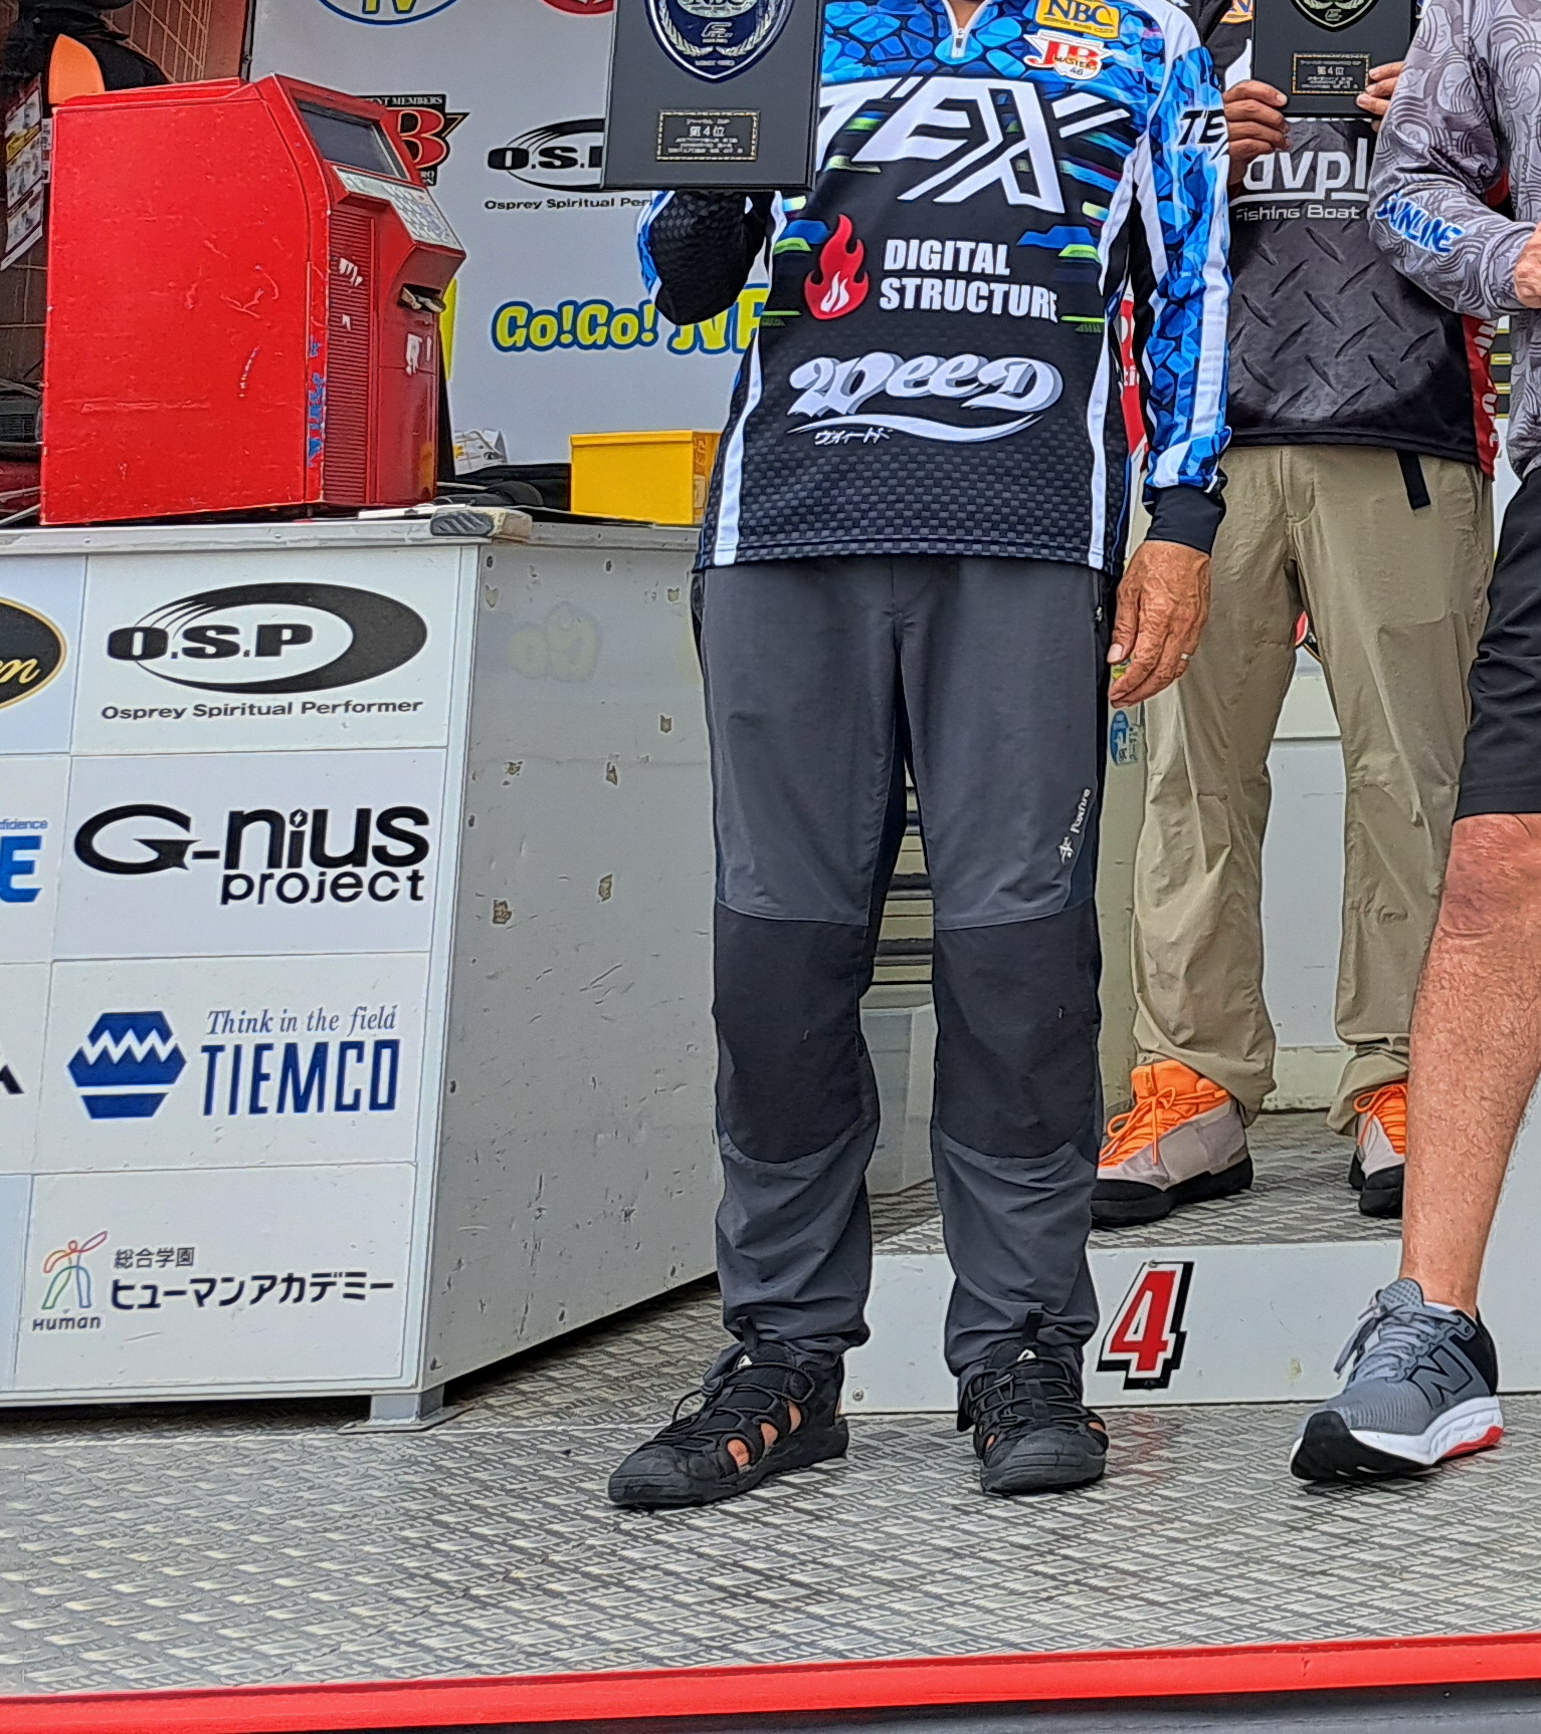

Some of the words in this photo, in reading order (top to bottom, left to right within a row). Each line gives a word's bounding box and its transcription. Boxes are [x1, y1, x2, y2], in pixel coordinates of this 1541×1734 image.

[484, 199, 543, 211] Osprey
[546, 197, 615, 210] Spiritual
[1306, 204, 1360, 220] Boat
[883, 237, 1011, 277] DIGITAL
[879, 276, 1059, 324] STRUCTURE
[494, 300, 657, 350] Go!Go!
[106, 623, 314, 662] O.S.P
[101, 705, 187, 721] Osprey
[192, 700, 294, 719] Spiritual
[300, 698, 424, 716] Performer
[73, 803, 431, 876] G-nius
[220, 868, 426, 906] project
[206, 1008, 274, 1036] Think
[279, 1007, 299, 1034] in
[306, 1008, 340, 1032] the
[346, 1004, 399, 1038] field
[200, 1038, 401, 1117] TIEMCO
[113, 1246, 196, 1269] 総合学園
[110, 1270, 395, 1311] ヒューマンアカデミー
[1097, 1259, 1194, 1391] 4
